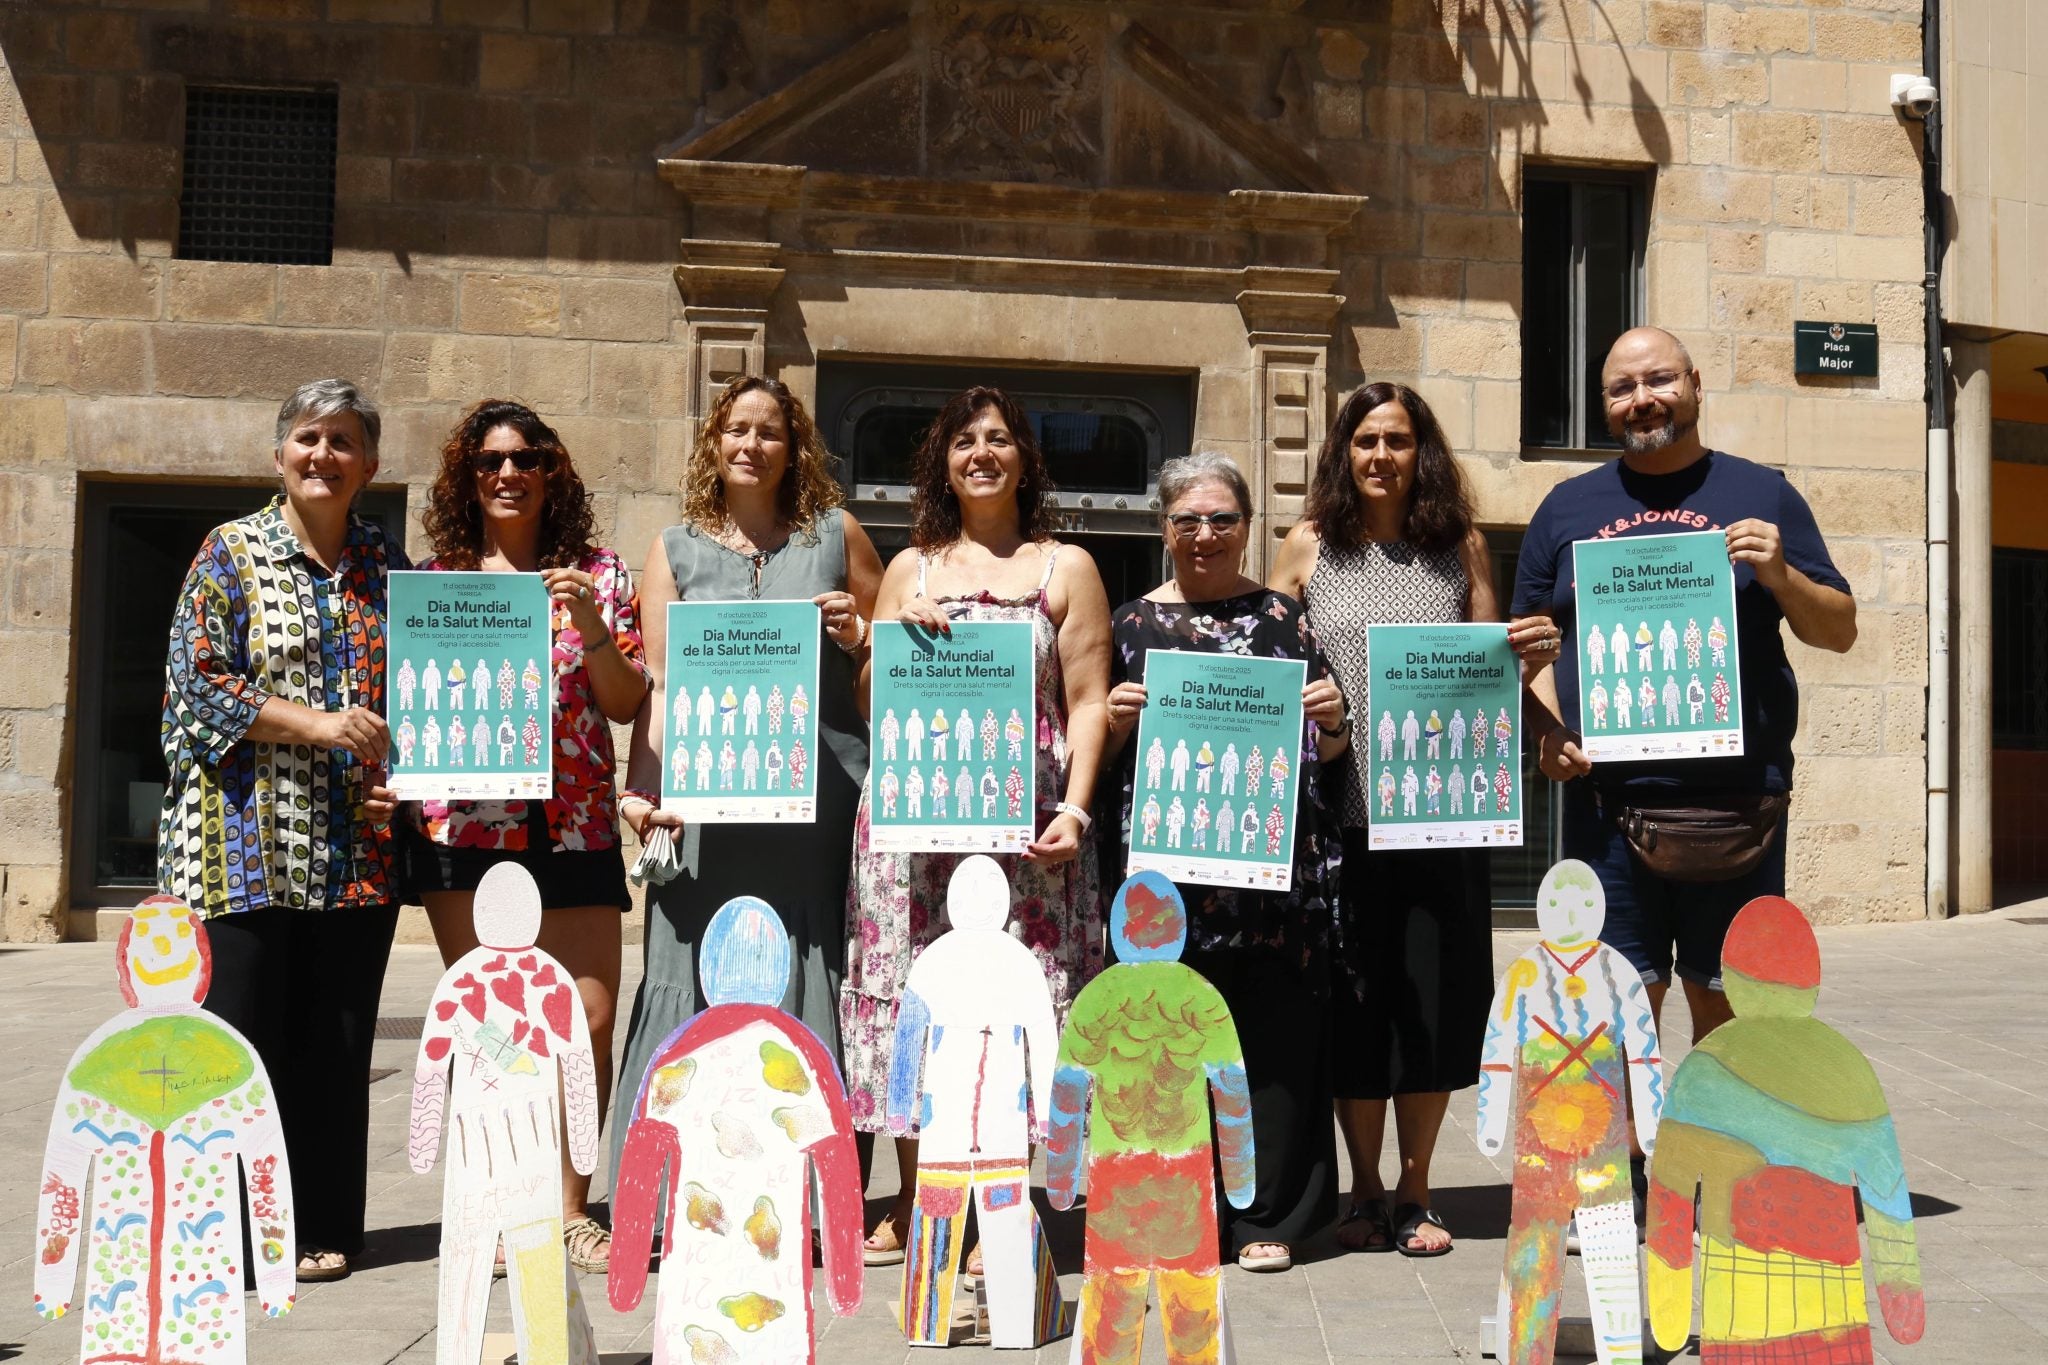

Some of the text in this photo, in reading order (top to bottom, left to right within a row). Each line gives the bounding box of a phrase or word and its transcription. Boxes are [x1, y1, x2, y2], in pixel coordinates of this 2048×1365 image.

[1823, 342, 1850, 352] Plaça
[1819, 357, 1854, 370] Major
[1612, 561, 1693, 579] Dia Mundial
[1592, 575, 1714, 595] de la Salut Mental
[1617, 596, 1641, 604] socials
[1642, 595, 1654, 603] per
[1687, 591, 1712, 599] mental
[428, 600, 511, 613] Dia Mundial
[1624, 605, 1643, 613] digna
[406, 616, 532, 628] de la Salut Mental
[703, 628, 781, 641] Dia Mundial
[437, 640, 458, 648] digna
[683, 643, 801, 656] de la Salut Mental
[911, 650, 994, 662] Dia Mundial
[1406, 651, 1486, 665] Dia Mundial
[712, 668, 731, 676] digna
[889, 665, 1015, 677] de la Salut Mental
[1385, 666, 1504, 680] de la Salut Mental
[893, 681, 914, 689] Drets
[915, 681, 938, 689] socials
[1182, 681, 1265, 699] Dia Mundial
[1477, 681, 1501, 689] mental
[921, 690, 941, 698] digna
[1416, 692, 1435, 700] digna
[1159, 695, 1284, 716] de la Salut Mental
[1162, 711, 1182, 719] Drets
[1183, 713, 1207, 721] socials
[1255, 719, 1280, 727] mental
[1188, 722, 1209, 731] digna
